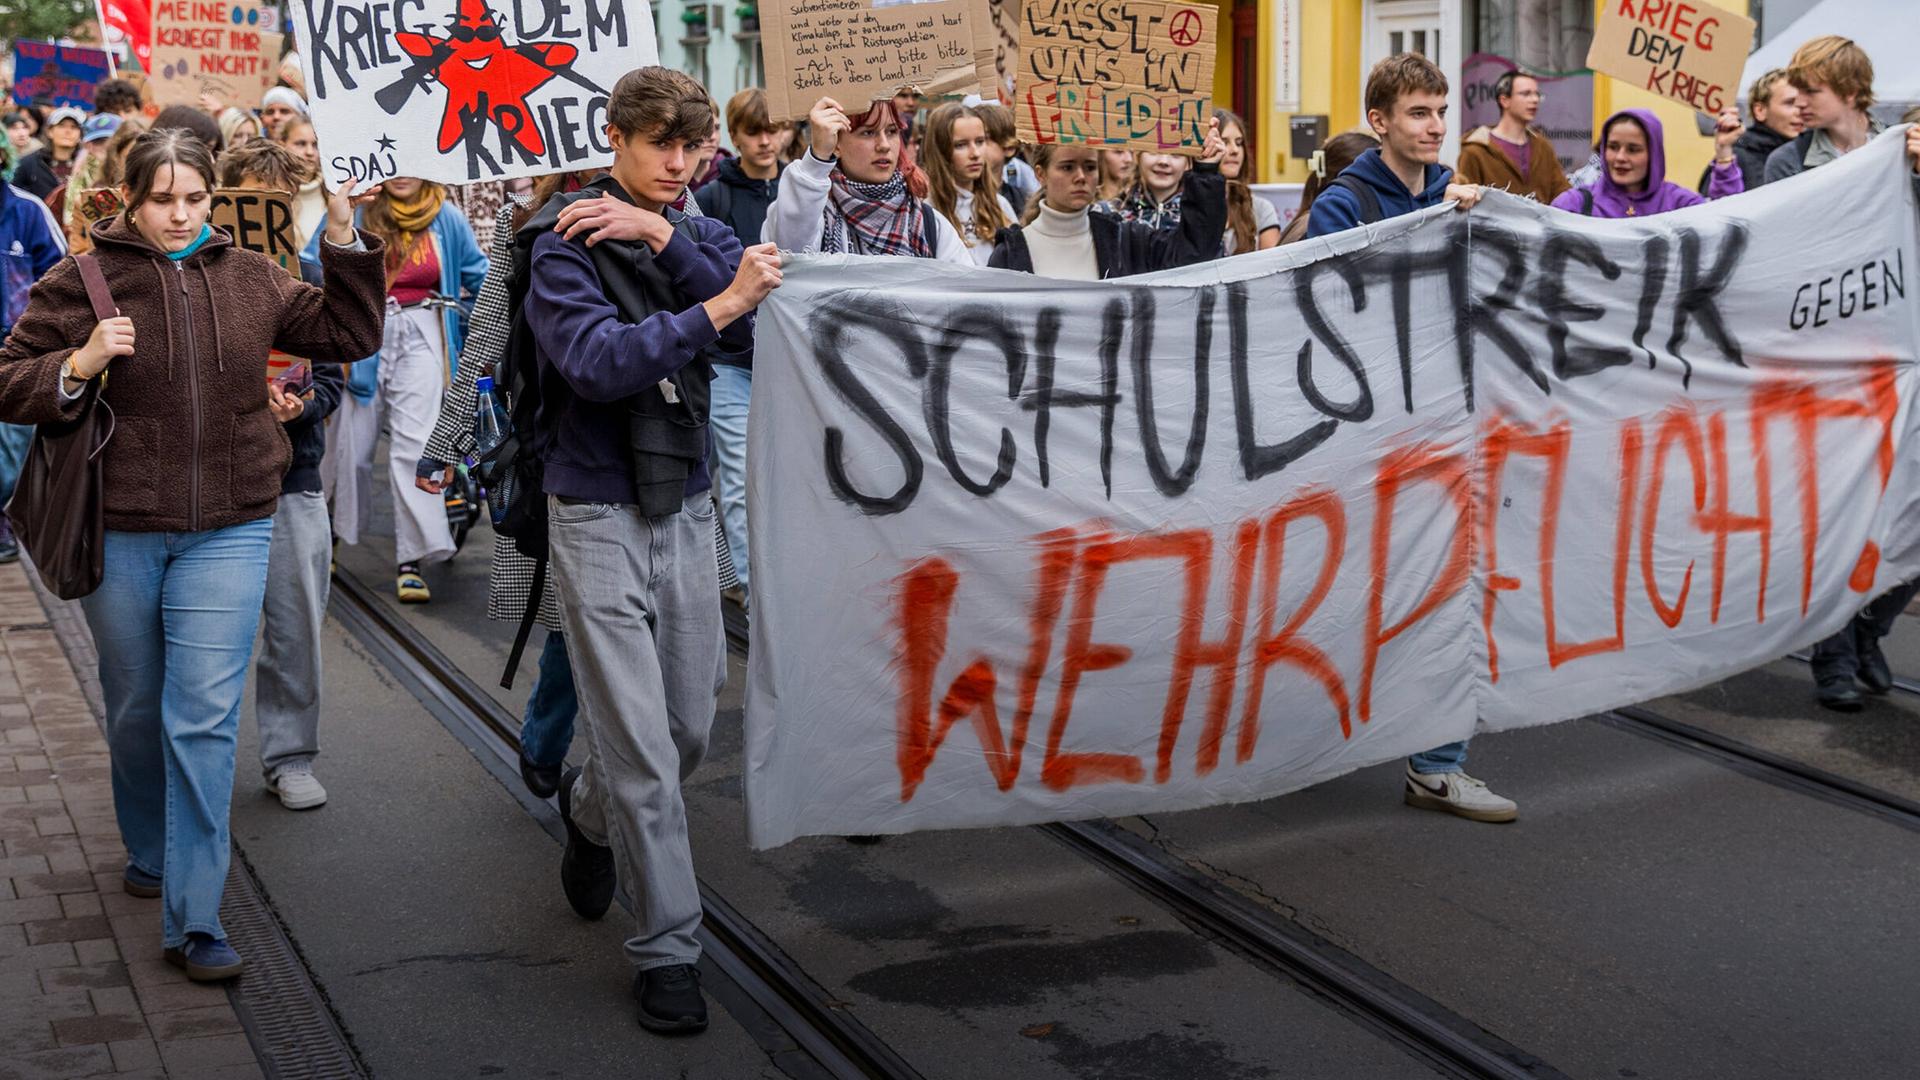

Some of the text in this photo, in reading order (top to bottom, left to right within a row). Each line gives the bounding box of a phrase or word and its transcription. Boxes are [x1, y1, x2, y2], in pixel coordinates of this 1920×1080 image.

[157, 0, 228, 24] MEINE
[790, 11, 878, 30] und weiter auf den
[847, 28, 858, 36] zu
[862, 22, 906, 35] zusteuern
[916, 16, 934, 29] und
[941, 12, 962, 26] kauf
[1027, 0, 1166, 53] LASST
[1617, 0, 1720, 52] KRIEG
[157, 27, 261, 51] KRIEGT IHR
[304, 0, 628, 99] KRIEG DEM
[796, 42, 819, 56] doch
[825, 37, 856, 52] einfach
[841, 55, 854, 72] ja
[865, 50, 888, 65] und
[897, 47, 928, 64] bitte
[936, 40, 968, 60] bitte
[1627, 27, 1685, 71] DEM
[828, 71, 842, 85] für
[848, 70, 873, 83] dieses
[1030, 45, 1125, 91] UNS
[1647, 66, 1724, 114] KRIEG
[458, 91, 617, 180] KRIEG
[331, 152, 397, 184] SDAJ
[1789, 247, 1906, 331] GEGEN
[808, 218, 1750, 516] SCHULSTREIK
[890, 357, 1899, 802] WEHRPFLICHT!
